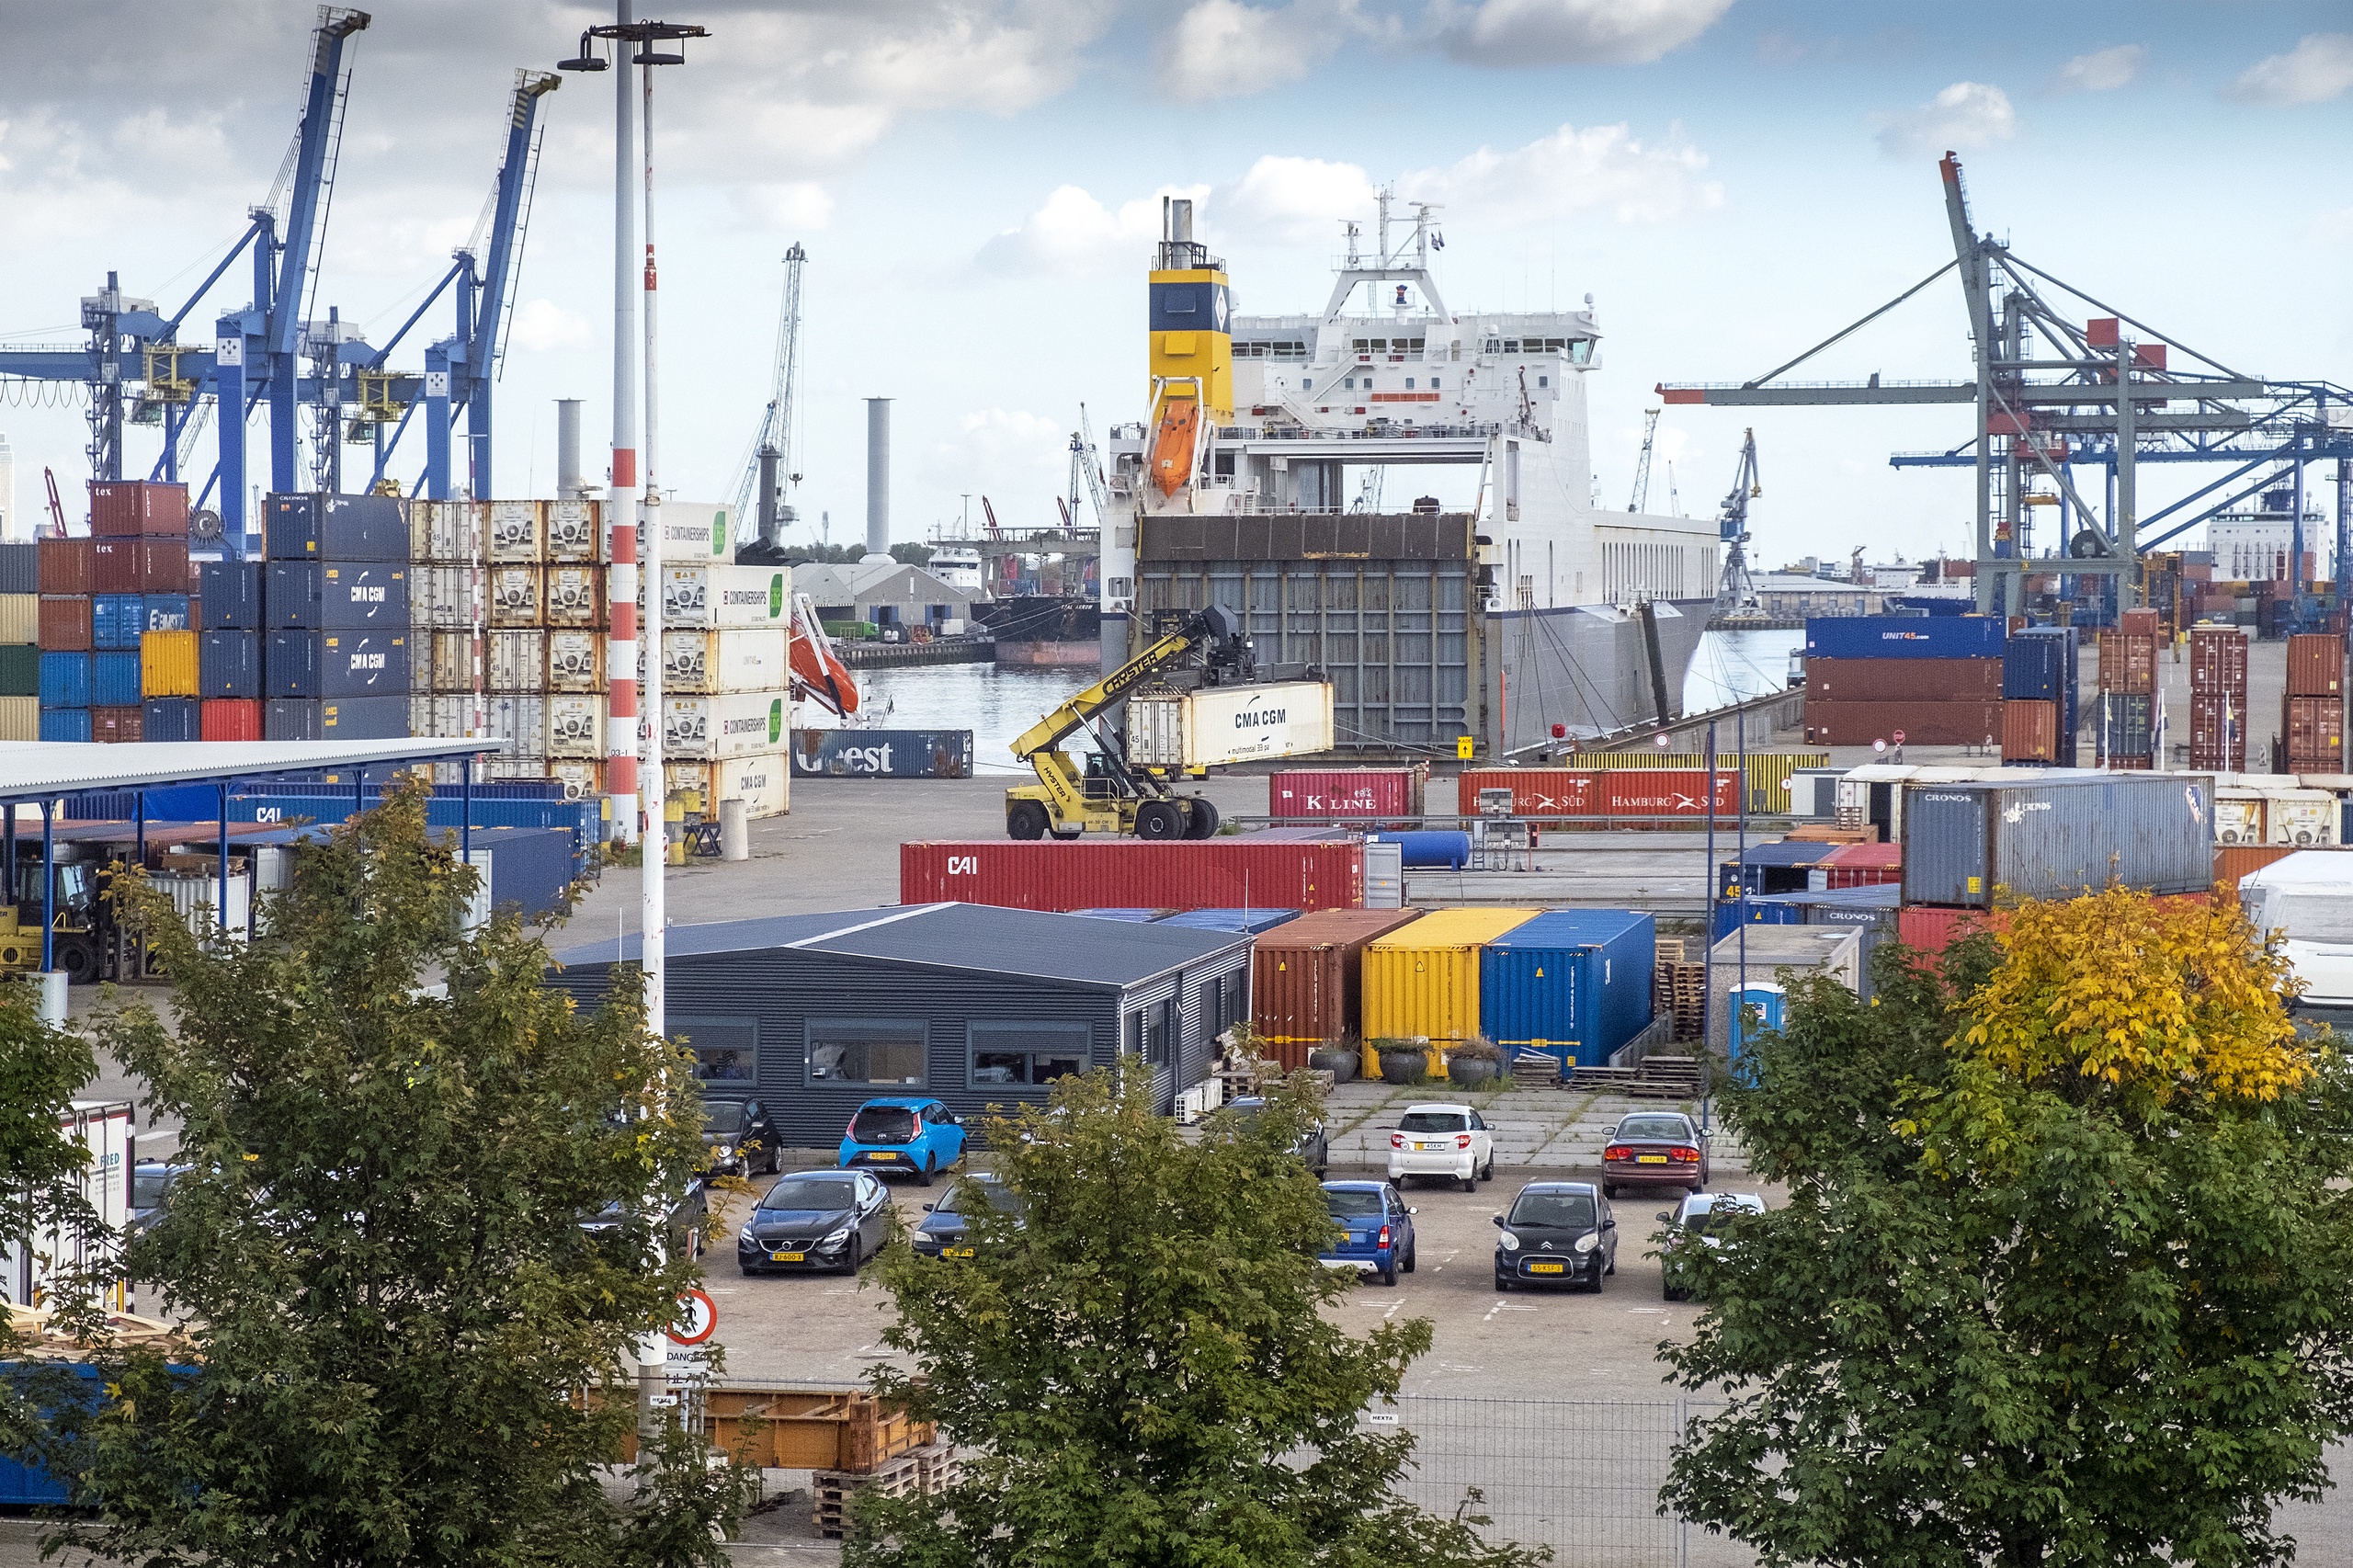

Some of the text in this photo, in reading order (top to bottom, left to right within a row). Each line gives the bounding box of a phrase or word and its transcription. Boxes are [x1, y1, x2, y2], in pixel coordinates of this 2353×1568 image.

[95, 487, 111, 496] tex
[671, 526, 709, 541] CONTAINERSHIPS
[96, 544, 112, 553] tex
[351, 586, 385, 602] CMA CGM
[729, 591, 767, 606] CONTAINERSHIPS
[350, 653, 385, 669] CMA CGM
[1111, 652, 1158, 690] HYSTER
[729, 717, 766, 734] CONTAINERSHIPS
[1235, 709, 1286, 729] CMA CGM
[1131, 735, 1140, 744] 45
[1043, 767, 1065, 800] HYSTER
[1330, 799, 1377, 810] LINE
[1562, 795, 1585, 807] SÜD
[1612, 796, 1672, 807] HAMBURG
[1925, 794, 1972, 802] CRONOS
[256, 807, 281, 823] CAI
[948, 856, 977, 875] CAI
[1726, 885, 1741, 898] 45
[1829, 912, 1876, 921] CRONOS
[666, 1352, 706, 1361] DANG
